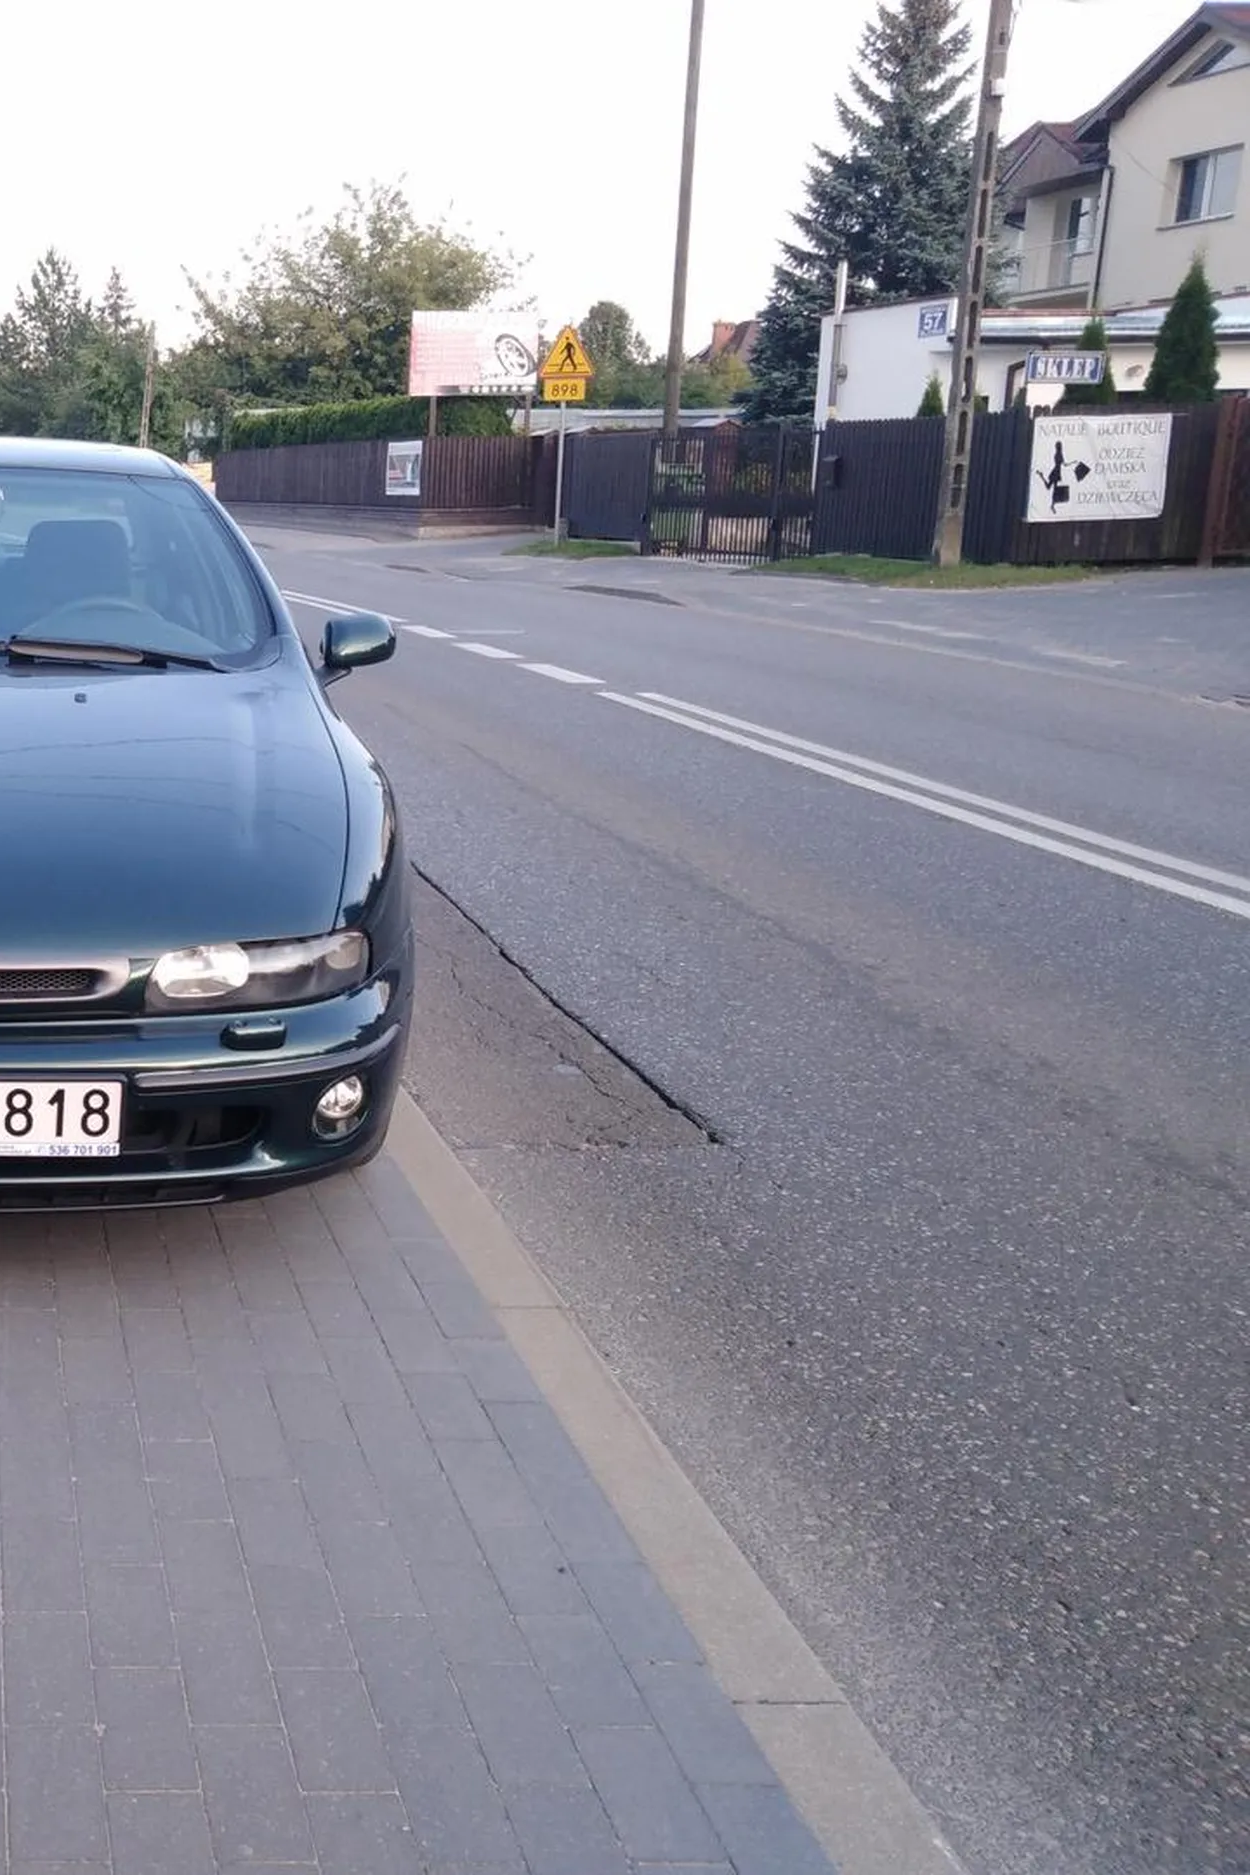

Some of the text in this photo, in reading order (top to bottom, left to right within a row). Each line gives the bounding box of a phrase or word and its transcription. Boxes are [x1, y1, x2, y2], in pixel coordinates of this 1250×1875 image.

[923, 312, 944, 331] 57
[1036, 355, 1096, 378] SKLEP
[551, 384, 579, 397] 898
[1097, 419, 1167, 437] BOUTIQUE
[1094, 461, 1147, 475] DAMSKA
[48, 1145, 118, 1156] 536 701 901
